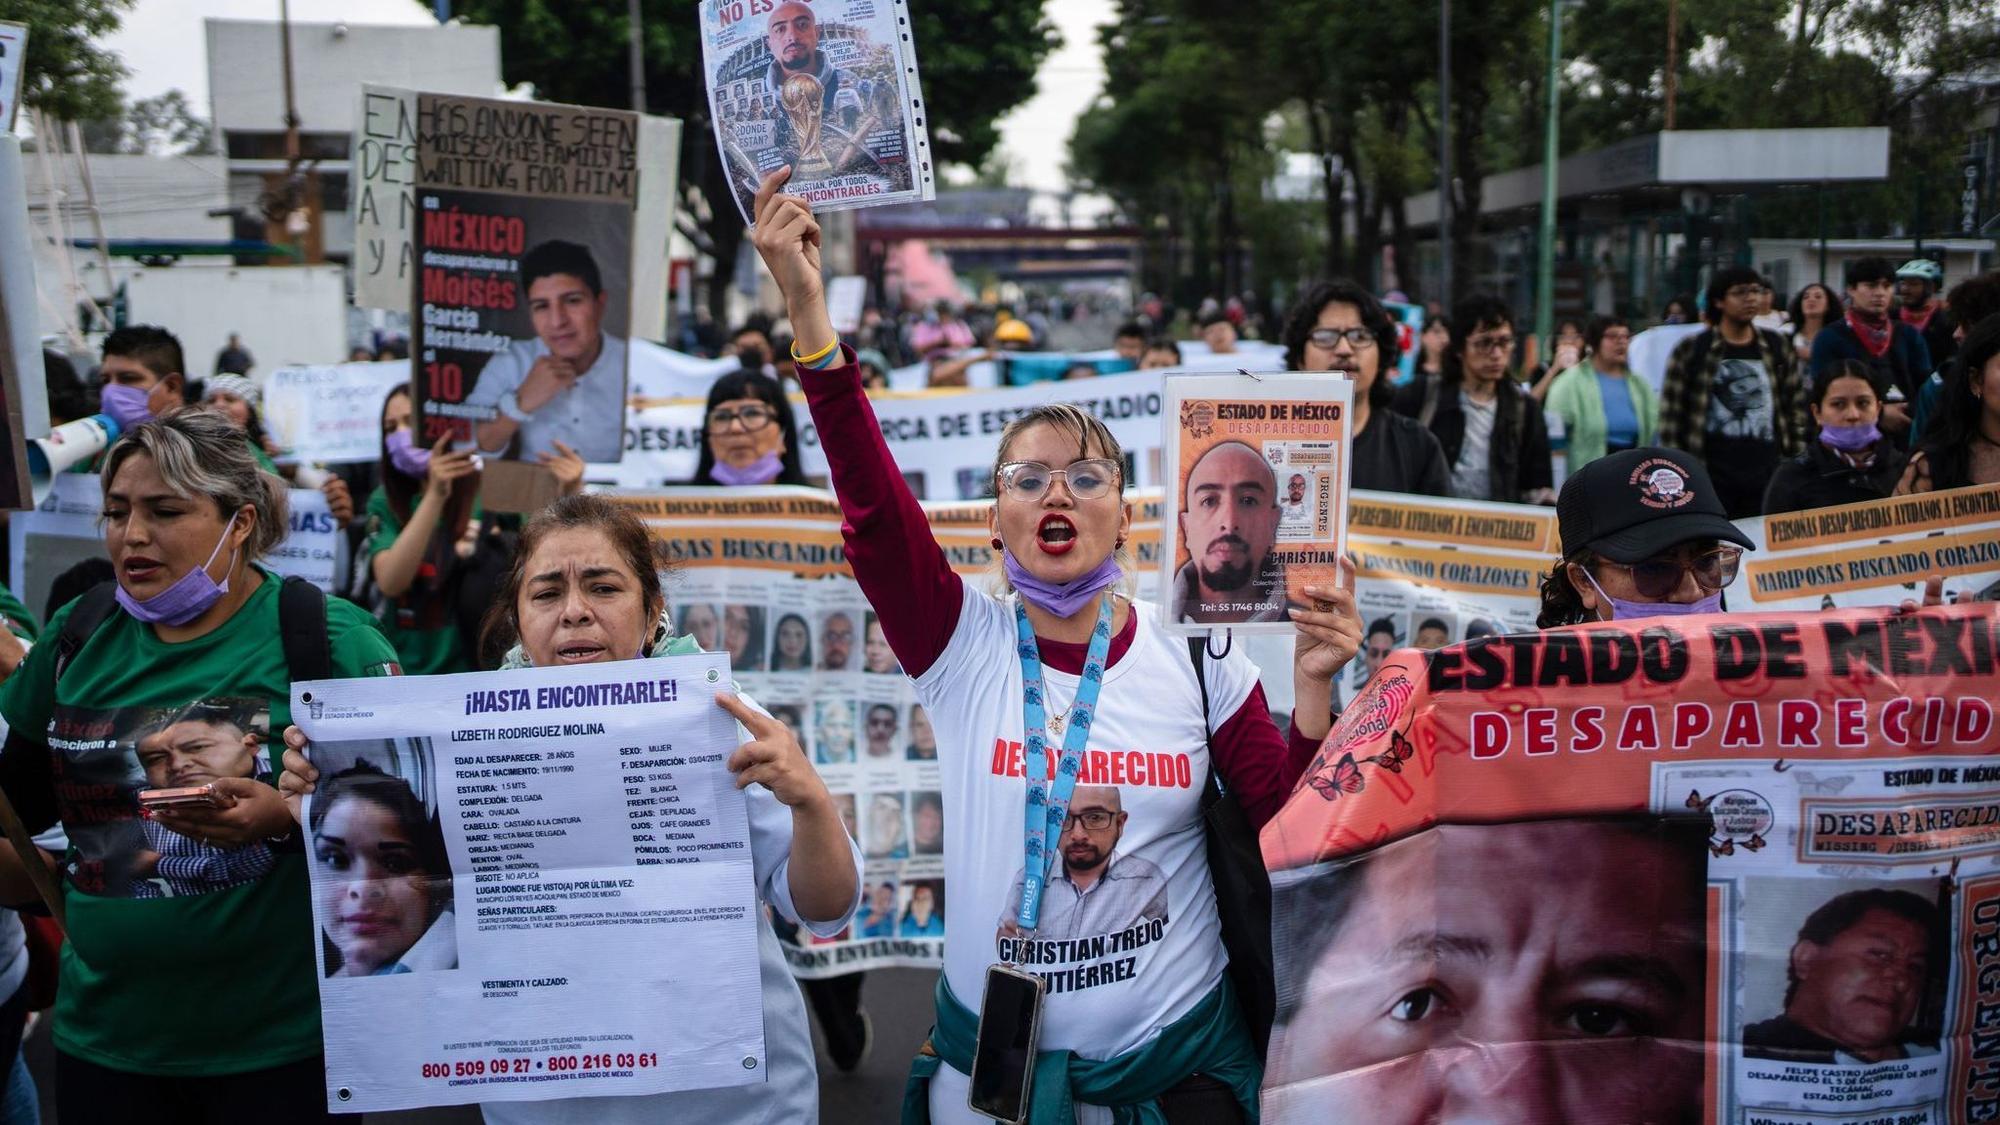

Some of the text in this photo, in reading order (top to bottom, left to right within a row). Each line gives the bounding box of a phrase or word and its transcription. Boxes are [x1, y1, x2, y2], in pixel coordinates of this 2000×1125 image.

[719, 0, 774, 27] NO ES
[825, 40, 856, 50] CHRISTIAN
[833, 48, 851, 56] TREJO
[417, 97, 639, 150] HAS ANYONE SEEN
[505, 141, 541, 163] HIS
[543, 143, 612, 170] FAMILY
[418, 153, 519, 192] WAITING
[527, 165, 567, 193] FOR
[827, 180, 844, 190] POR
[423, 197, 440, 209] en
[424, 205, 526, 255] MÉXICO
[422, 267, 516, 310] Moisés
[422, 303, 480, 329] García
[423, 326, 511, 353] Hernández
[426, 363, 463, 401] 10
[1086, 393, 1160, 420] TADIO
[1217, 402, 1341, 420] ESTADO DE MÉXICO
[939, 413, 971, 438] DE
[1228, 422, 1330, 434] DESAPARECIDO
[665, 502, 784, 516] DESAPARECIDAS
[1318, 476, 1330, 532] URGENTE
[1405, 507, 1537, 542] AYUDANOS A ENCONTRARLES
[1770, 518, 1818, 544] PERSONAS
[1819, 505, 1893, 537] DESAPARECIDAS
[1893, 497, 1942, 526] AYUDANOS
[1944, 496, 1951, 519] A
[722, 538, 844, 567] BUSCANDO
[1271, 551, 1335, 564] CHRISTIAN
[1363, 552, 1435, 578] BUSCANDO
[1440, 560, 1531, 590] CORAZONES
[1755, 540, 2000, 593] MARIPOSAS BUSCANDO CORAZO
[1200, 602, 1279, 612] Tel: 55 1746 8004
[1427, 627, 1690, 692] ESTADO
[1711, 621, 1806, 679] DE
[465, 679, 678, 715] ¡HASTA ENCONTRARLE!
[451, 723, 605, 742] LIZBETH RODRIGUEZ MOLINA
[107, 739, 116, 749] a
[619, 744, 672, 755] SEXO: MUJER
[454, 750, 575, 765] EDAD AL DESAPARECER: 28 AÑOS
[630, 757, 687, 769] DESAPARICIÓN:
[456, 770, 479, 779] FECHA
[480, 769, 491, 778] DE
[492, 767, 540, 777] NACIMIENTO:
[623, 773, 657, 783] PESO: 53
[1884, 769, 1933, 787] ESTADO
[1938, 768, 1958, 783] DE
[457, 784, 498, 794] ESTATURA:
[625, 784, 677, 796] TEZ: BLANCA
[459, 793, 543, 806] COMPLEXIÓN: DELGADA
[627, 795, 680, 807] FRENTE: CHICA
[461, 808, 520, 819] CARA: OVALADA
[629, 807, 697, 819] CEJAS: DEPILADAS
[463, 822, 500, 831] CABELLO:
[503, 819, 535, 829] CASTAÑO
[552, 816, 581, 825] CINTURA
[631, 818, 711, 830] OJOS: CAFE GRANDES
[1817, 806, 2000, 836] DESAPARECID
[633, 832, 695, 842] BOCA: MEDIANA
[635, 841, 744, 854] PÓMULOS: POCO PROMINENTES
[1816, 842, 1876, 852] MISSING
[476, 879, 635, 895] LUGAR DONDE FUE VISTO(A) POR ÚLTIMA VEZ:
[477, 904, 558, 917] SEÑAS PARTICULARES:
[1000, 917, 1163, 965] CHRISTIAN TREJO
[482, 977, 568, 989] VESTIMENTA Y CALZADO:
[422, 1053, 657, 1078] 800 509 09 27 800 216 03 61
[1785, 1064, 1909, 1078] FELIPE CASTRO JARAMILLO
[1822, 1077, 1833, 1085] EL
[1859, 1072, 1904, 1084] DICIEMBRE
[1803, 1092, 1847, 1101] ESTADO
[1849, 1093, 1859, 1101] DE
